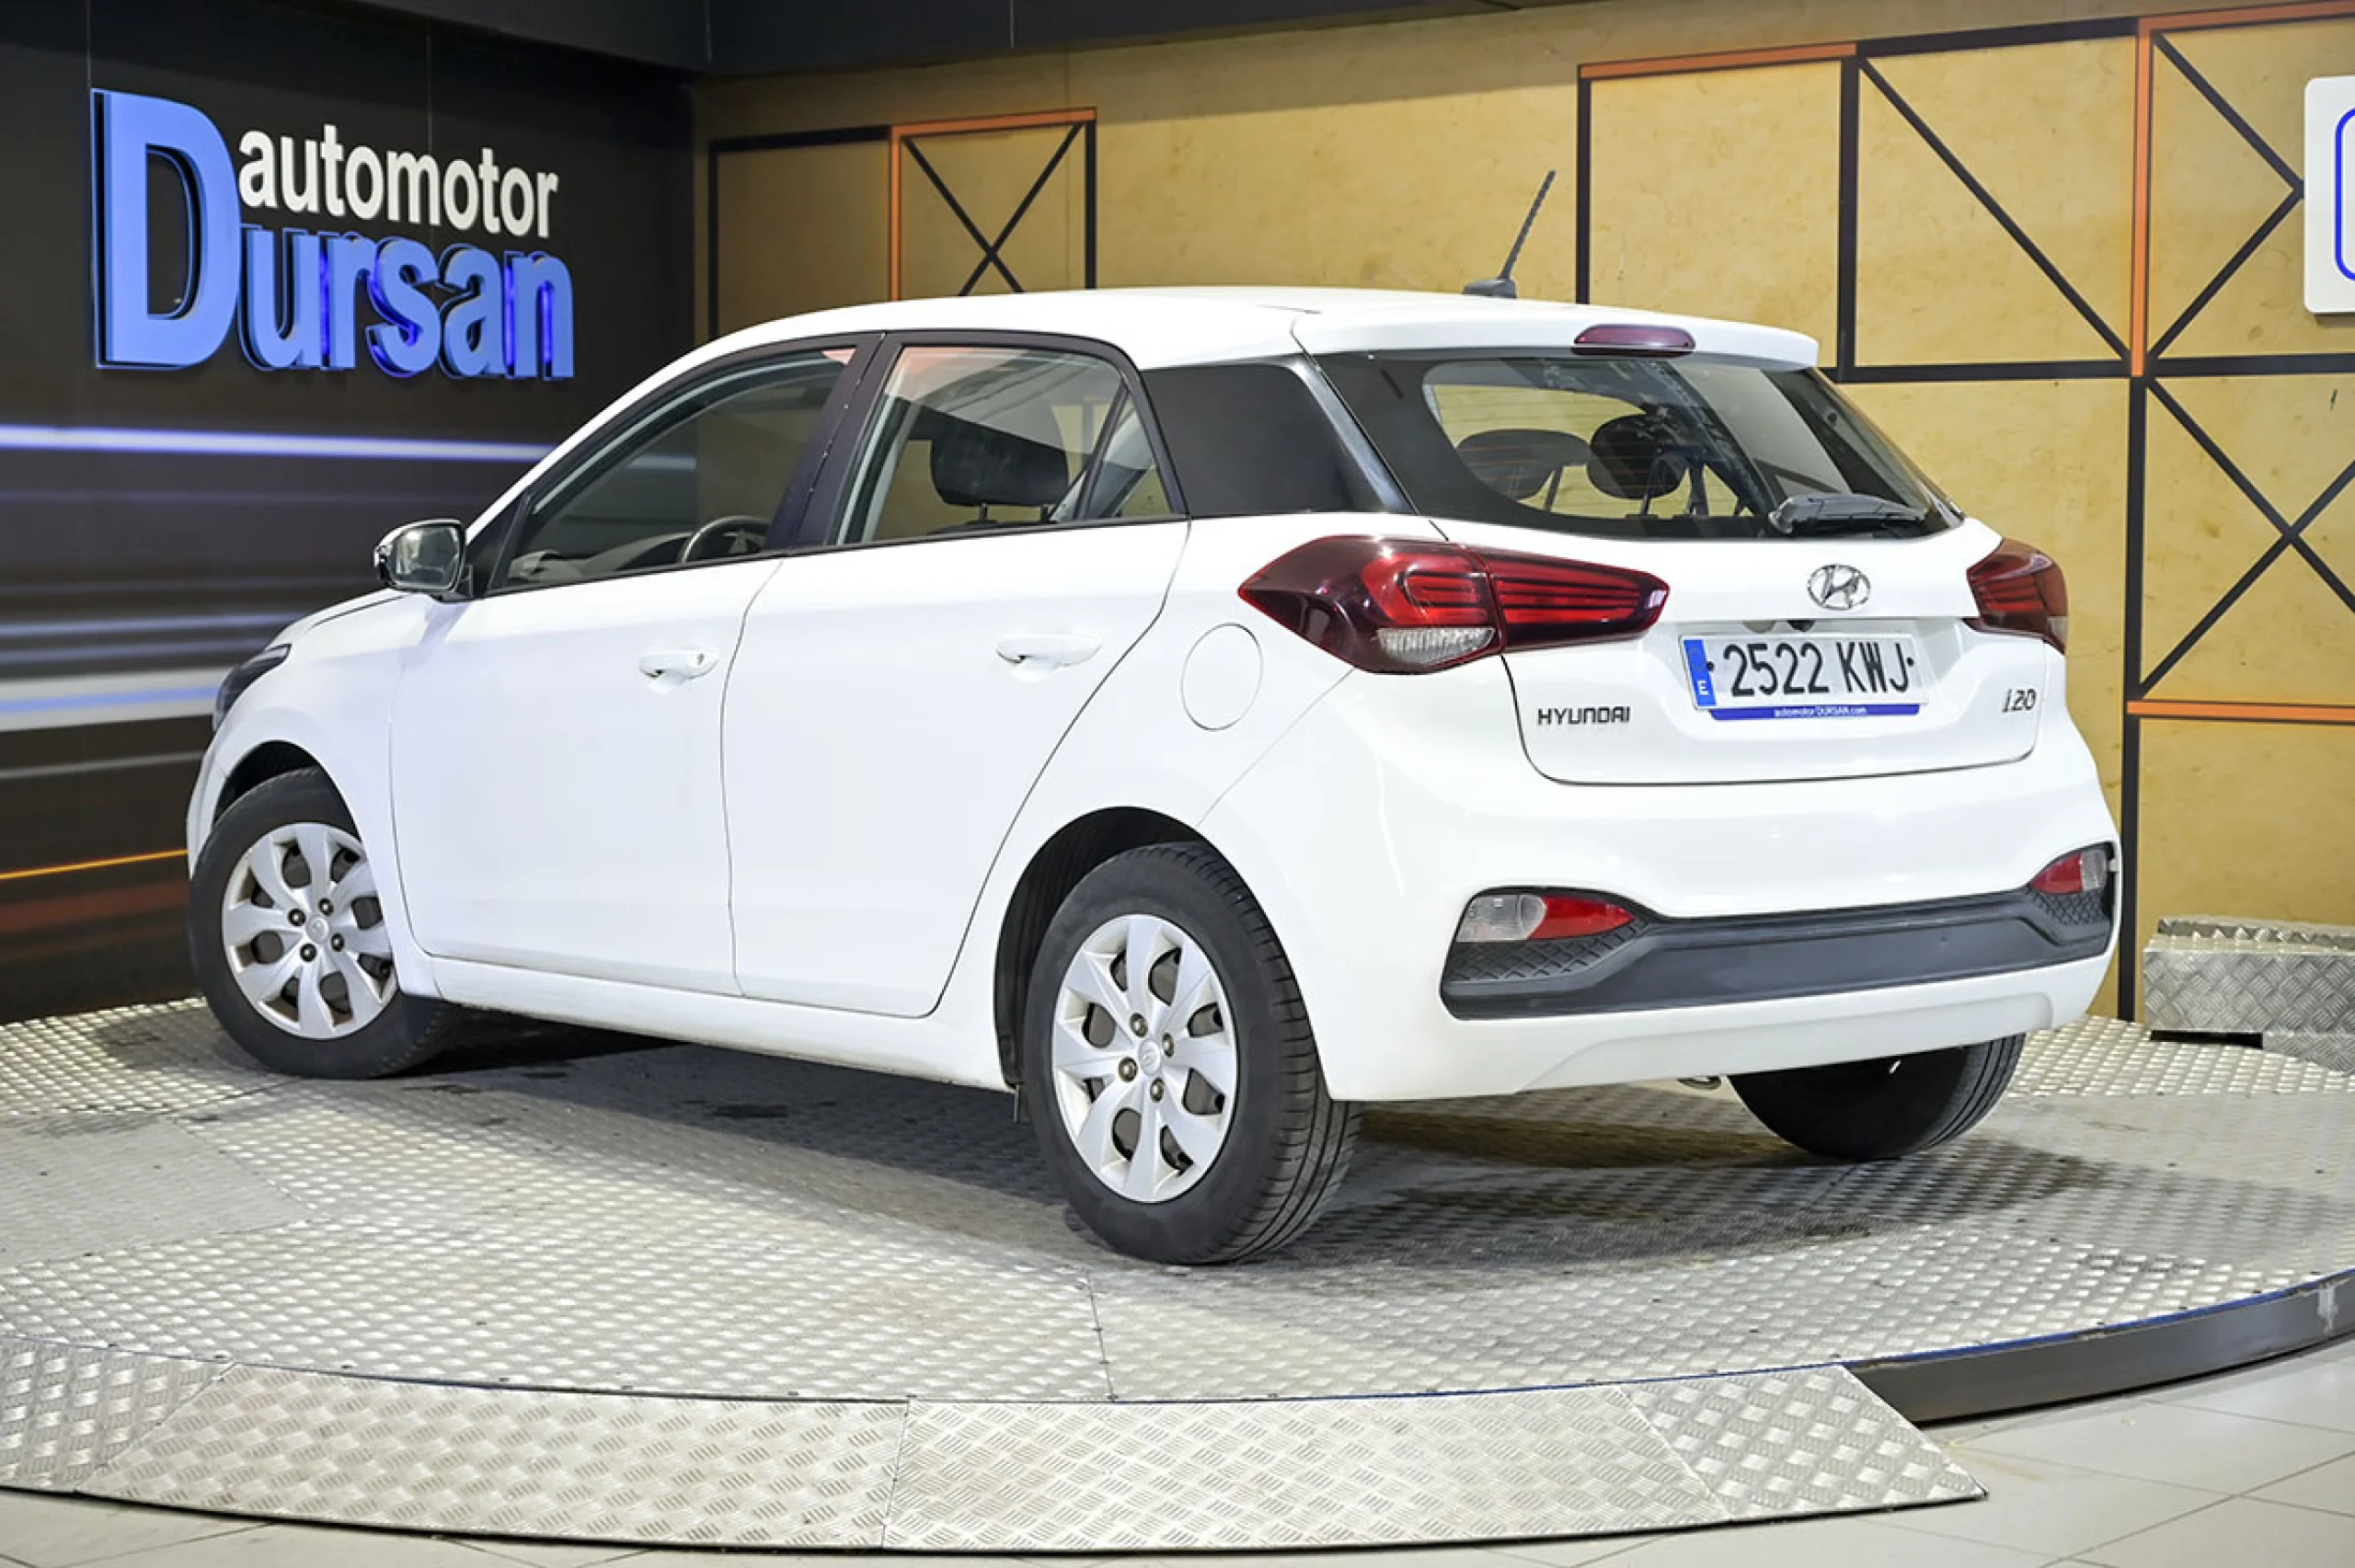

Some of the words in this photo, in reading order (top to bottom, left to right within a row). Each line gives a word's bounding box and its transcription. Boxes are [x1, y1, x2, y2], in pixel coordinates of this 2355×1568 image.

[238, 123, 558, 239] automotor
[89, 87, 576, 380] Dursan
[1697, 679, 1709, 696] E
[1722, 642, 1831, 697] 2522
[1836, 641, 1909, 693] KWJ
[1537, 705, 1631, 726] HYUNDAI
